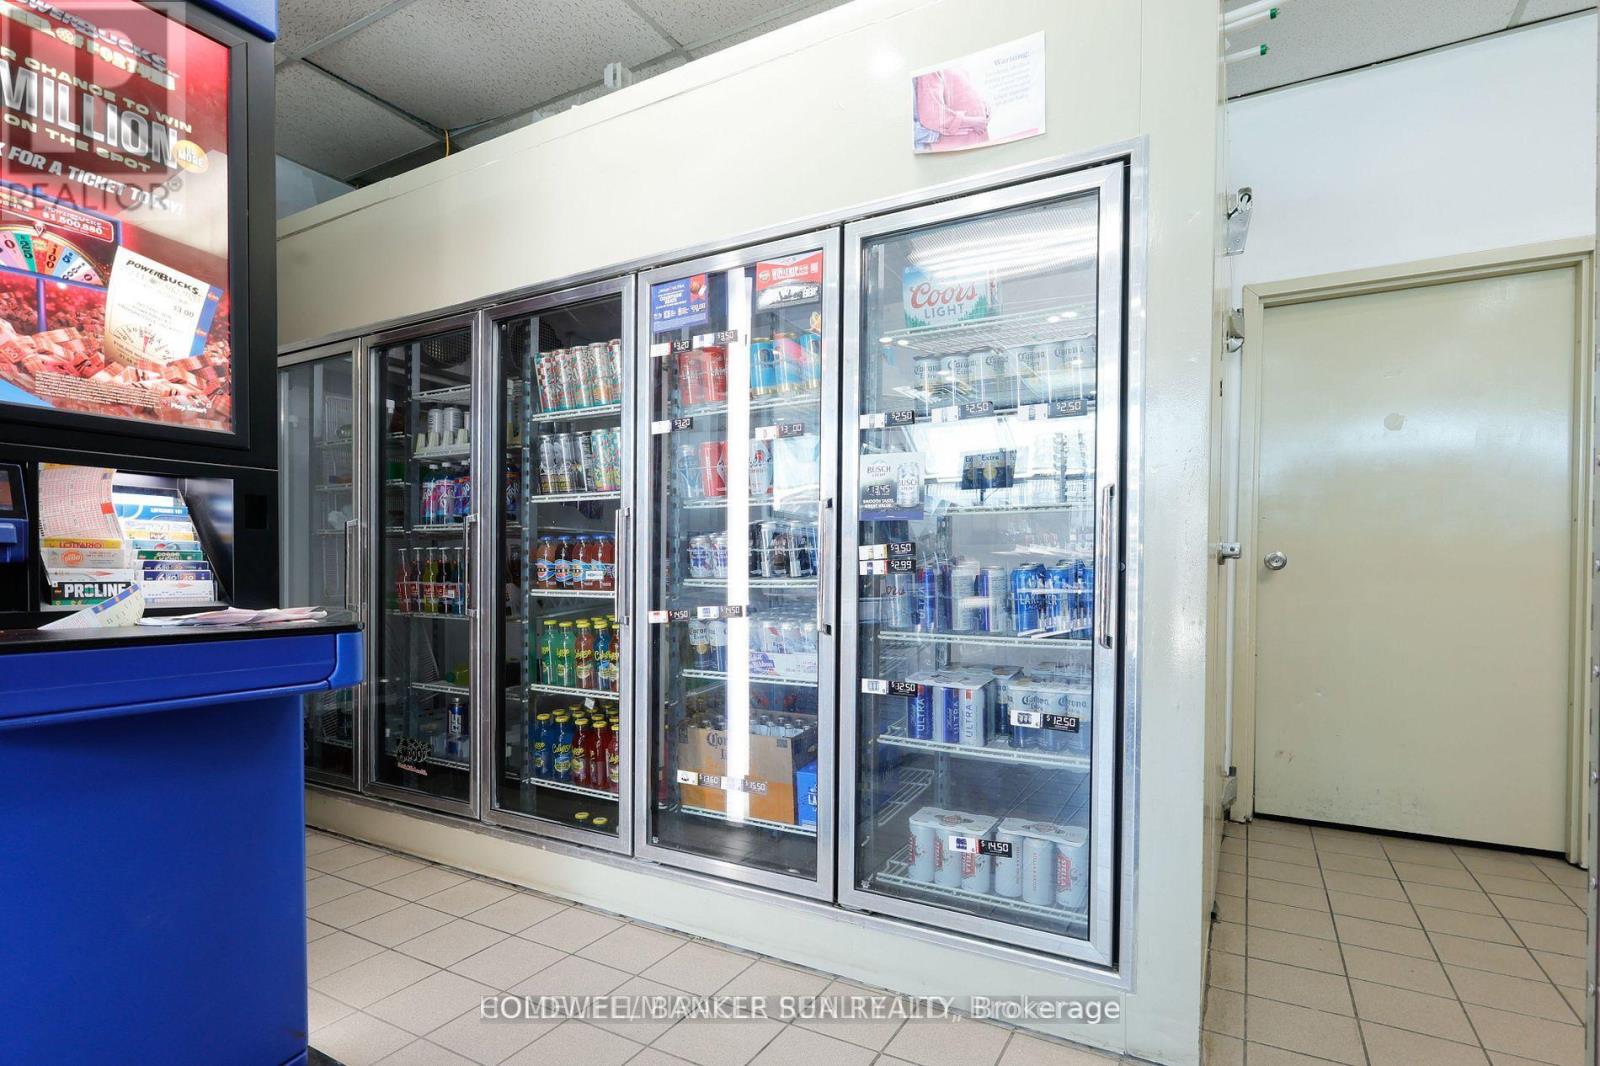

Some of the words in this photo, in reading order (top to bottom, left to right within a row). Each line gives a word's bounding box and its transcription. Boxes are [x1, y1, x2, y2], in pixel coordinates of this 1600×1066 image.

[24, 56, 117, 102] CHANCE
[122, 97, 149, 115] TO
[155, 111, 192, 134] WIN
[0, 59, 178, 170] MILLION
[4, 113, 37, 134] ON
[45, 127, 89, 153] THE
[96, 147, 151, 173] SPOT
[8, 147, 46, 170] FOR
[49, 160, 62, 177] A
[68, 165, 126, 197] TICKET
[126, 258, 200, 296] POWERBUCKS
[910, 281, 977, 309] Coors
[924, 303, 966, 320] LIGHT
[965, 402, 989, 413] $2.50
[1056, 401, 1081, 413] $2.50
[891, 411, 912, 422] $2.50
[866, 465, 892, 475] BUSCH
[890, 543, 912, 554] $3.50
[890, 560, 912, 571] $2.99
[917, 698, 926, 732] ULTRA
[965, 704, 973, 738] ULTRA
[1046, 715, 1076, 728] $12.50
[980, 839, 1009, 853] $14.50
